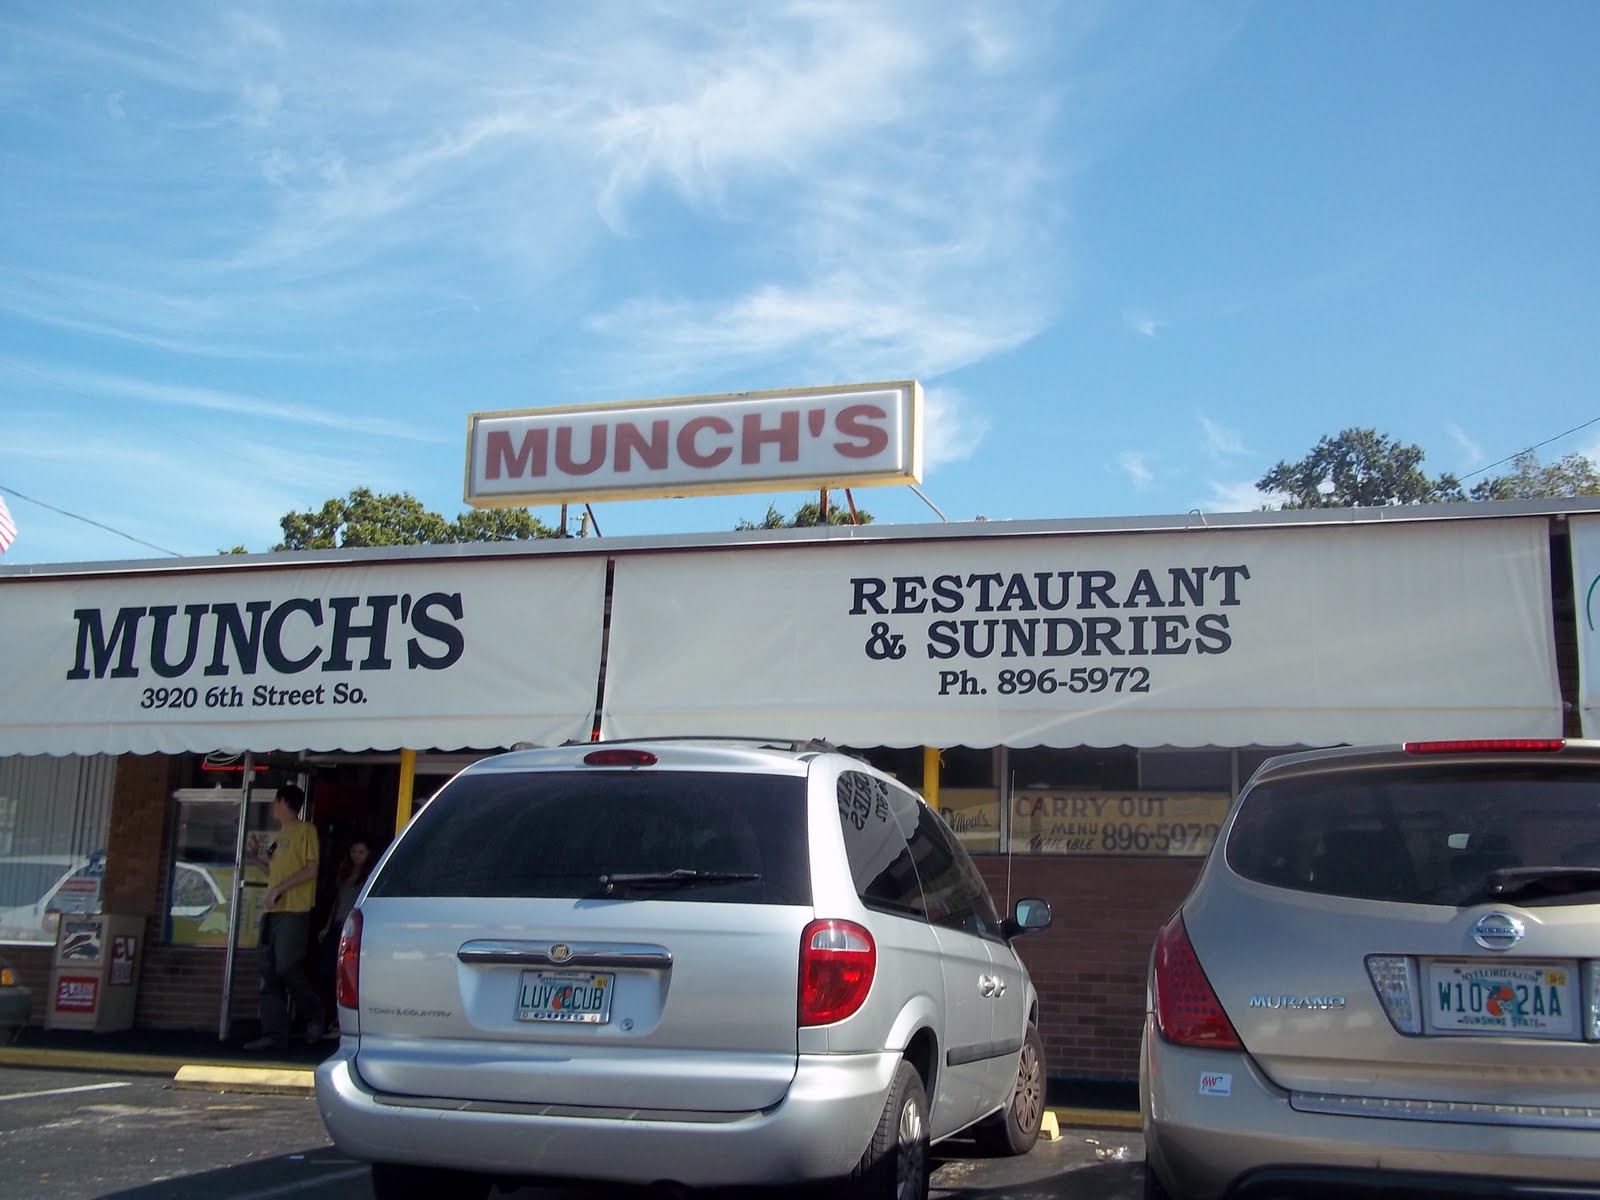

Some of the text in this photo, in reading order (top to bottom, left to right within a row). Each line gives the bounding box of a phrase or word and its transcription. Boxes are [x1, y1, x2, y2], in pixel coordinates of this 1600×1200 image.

[485, 404, 889, 480] MUNCH'S
[849, 565, 1251, 615] RESTAURANT
[66, 592, 465, 680] MUNCH'S
[865, 614, 1233, 660] & SUNDRIES
[140, 681, 368, 709] 3920 6th Street So.
[938, 667, 1151, 696] Ph. 896-5972
[1015, 796, 1168, 818] CARRY OUT
[1051, 822, 1099, 835] MENU
[521, 985, 604, 1010] LUV CUB
[1250, 995, 1346, 1010] MURANO
[1516, 984, 1562, 1016] 2AA
